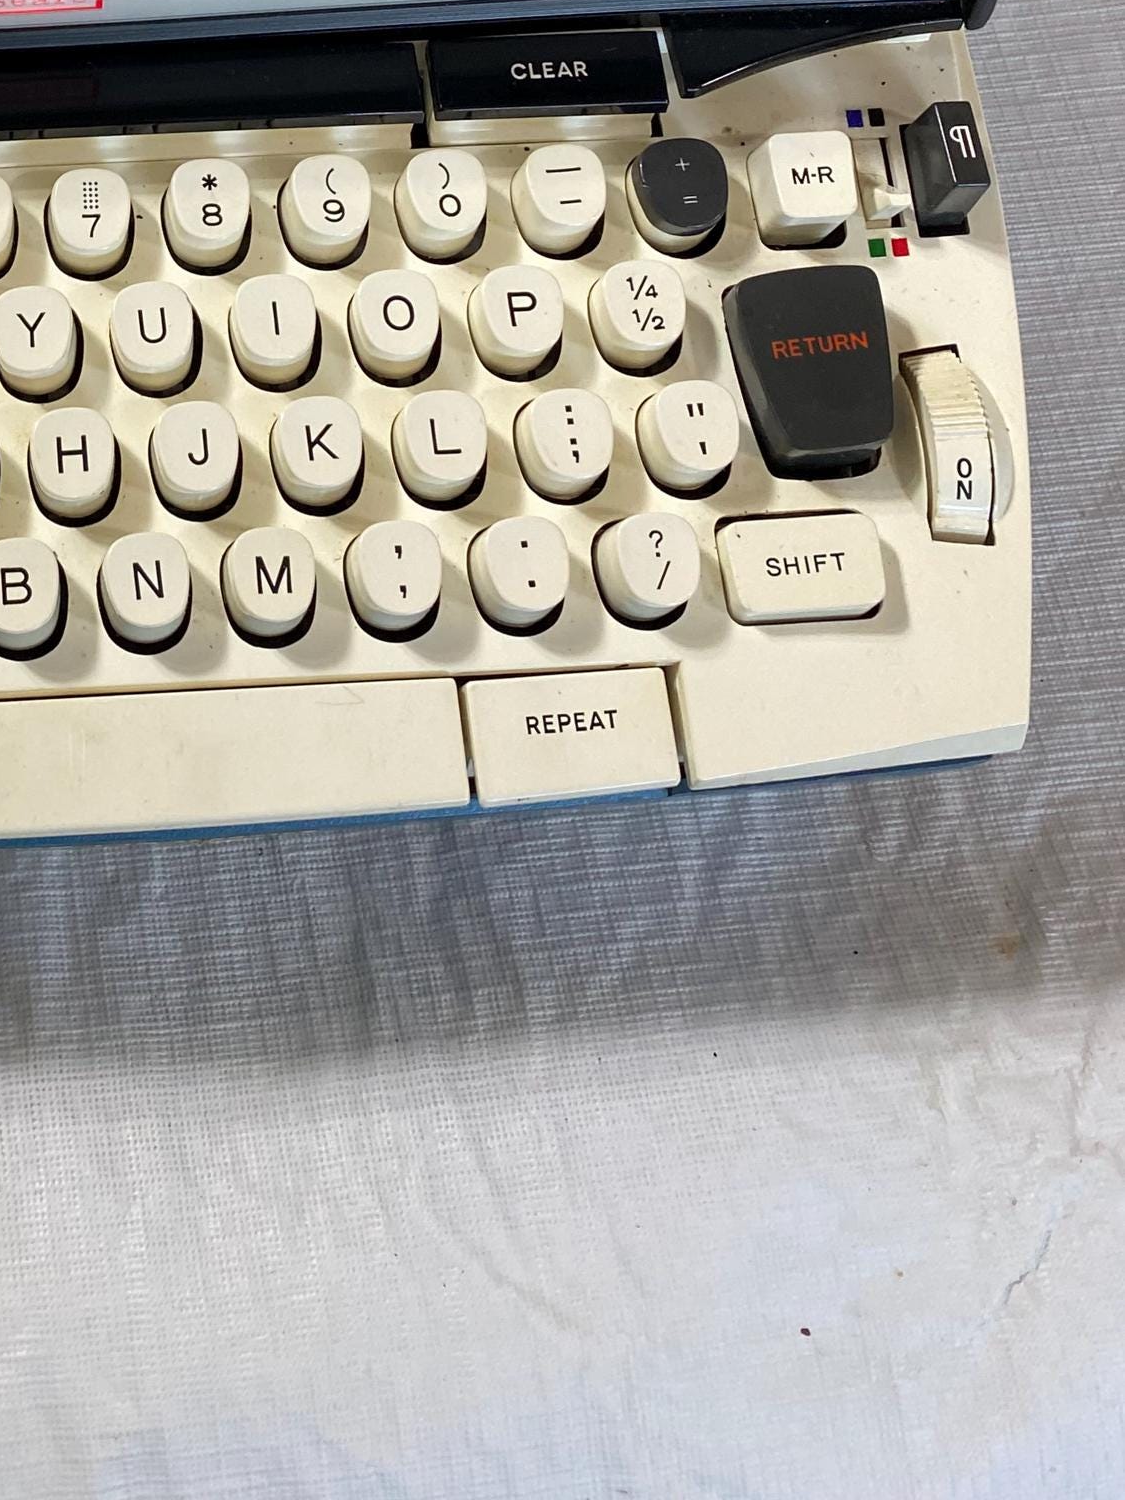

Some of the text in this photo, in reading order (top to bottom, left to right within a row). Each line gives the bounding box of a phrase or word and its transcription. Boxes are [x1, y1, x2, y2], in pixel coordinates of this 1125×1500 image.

[510, 61, 588, 80] CLEAR
[791, 166, 835, 185] M-R
[81, 213, 101, 238] 7
[201, 203, 223, 227] 8
[322, 199, 345, 223] 9
[137, 307, 167, 344] U
[271, 301, 280, 336] I
[382, 295, 415, 331] O
[506, 291, 537, 327] P
[16, 312, 46, 348] Y
[770, 329, 871, 360] RETURN
[56, 434, 89, 474] H
[187, 428, 209, 466] J
[305, 423, 339, 461] K
[429, 418, 462, 455] L
[648, 530, 663, 558] ?
[132, 560, 165, 601] N
[255, 555, 293, 595] M
[656, 560, 671, 590] /
[765, 552, 845, 577] SHIFT
[0, 567, 33, 606] B
[525, 709, 618, 735] REPEAT
